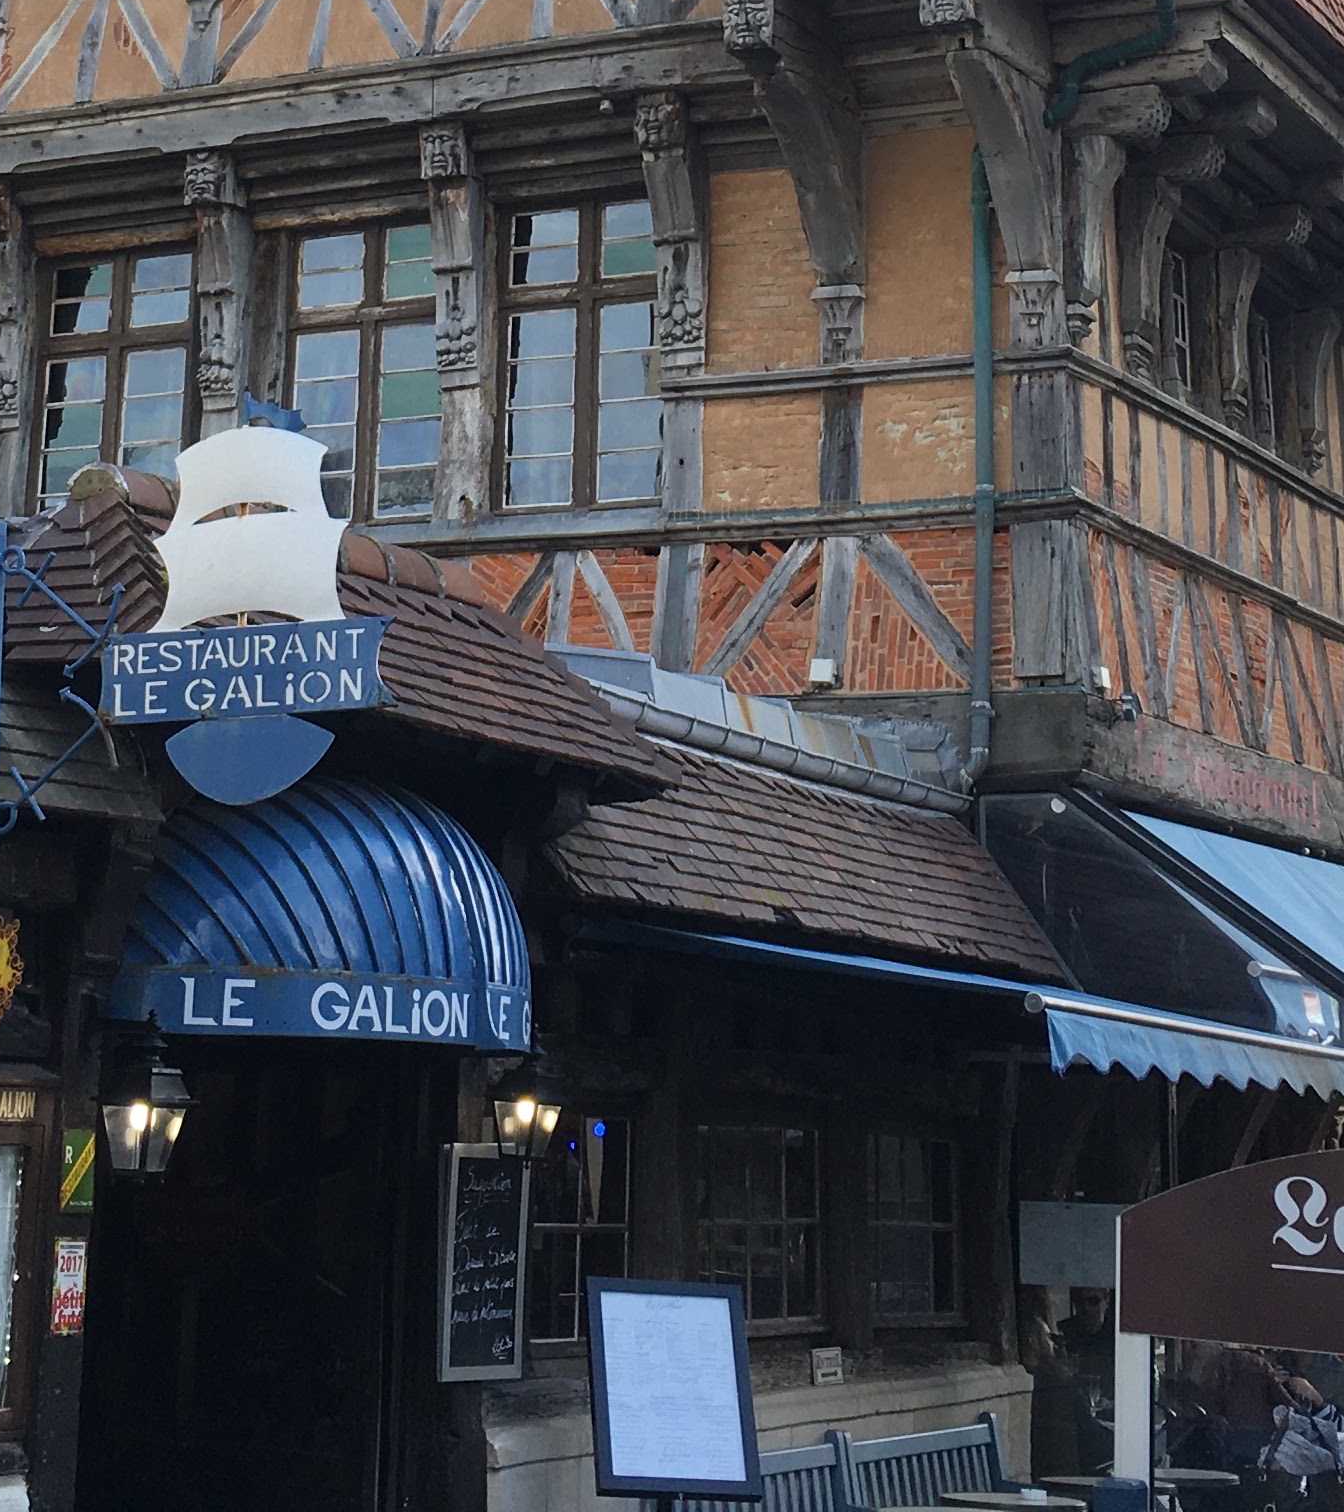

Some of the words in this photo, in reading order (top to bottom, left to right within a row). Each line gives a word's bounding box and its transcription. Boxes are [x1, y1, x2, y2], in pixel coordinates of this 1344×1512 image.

[113, 628, 365, 676] RESTAURANT
[113, 680, 167, 717] LE
[180, 977, 256, 1027] LE
[486, 988, 511, 1041] LE
[59, 1254, 84, 1273] 2017
